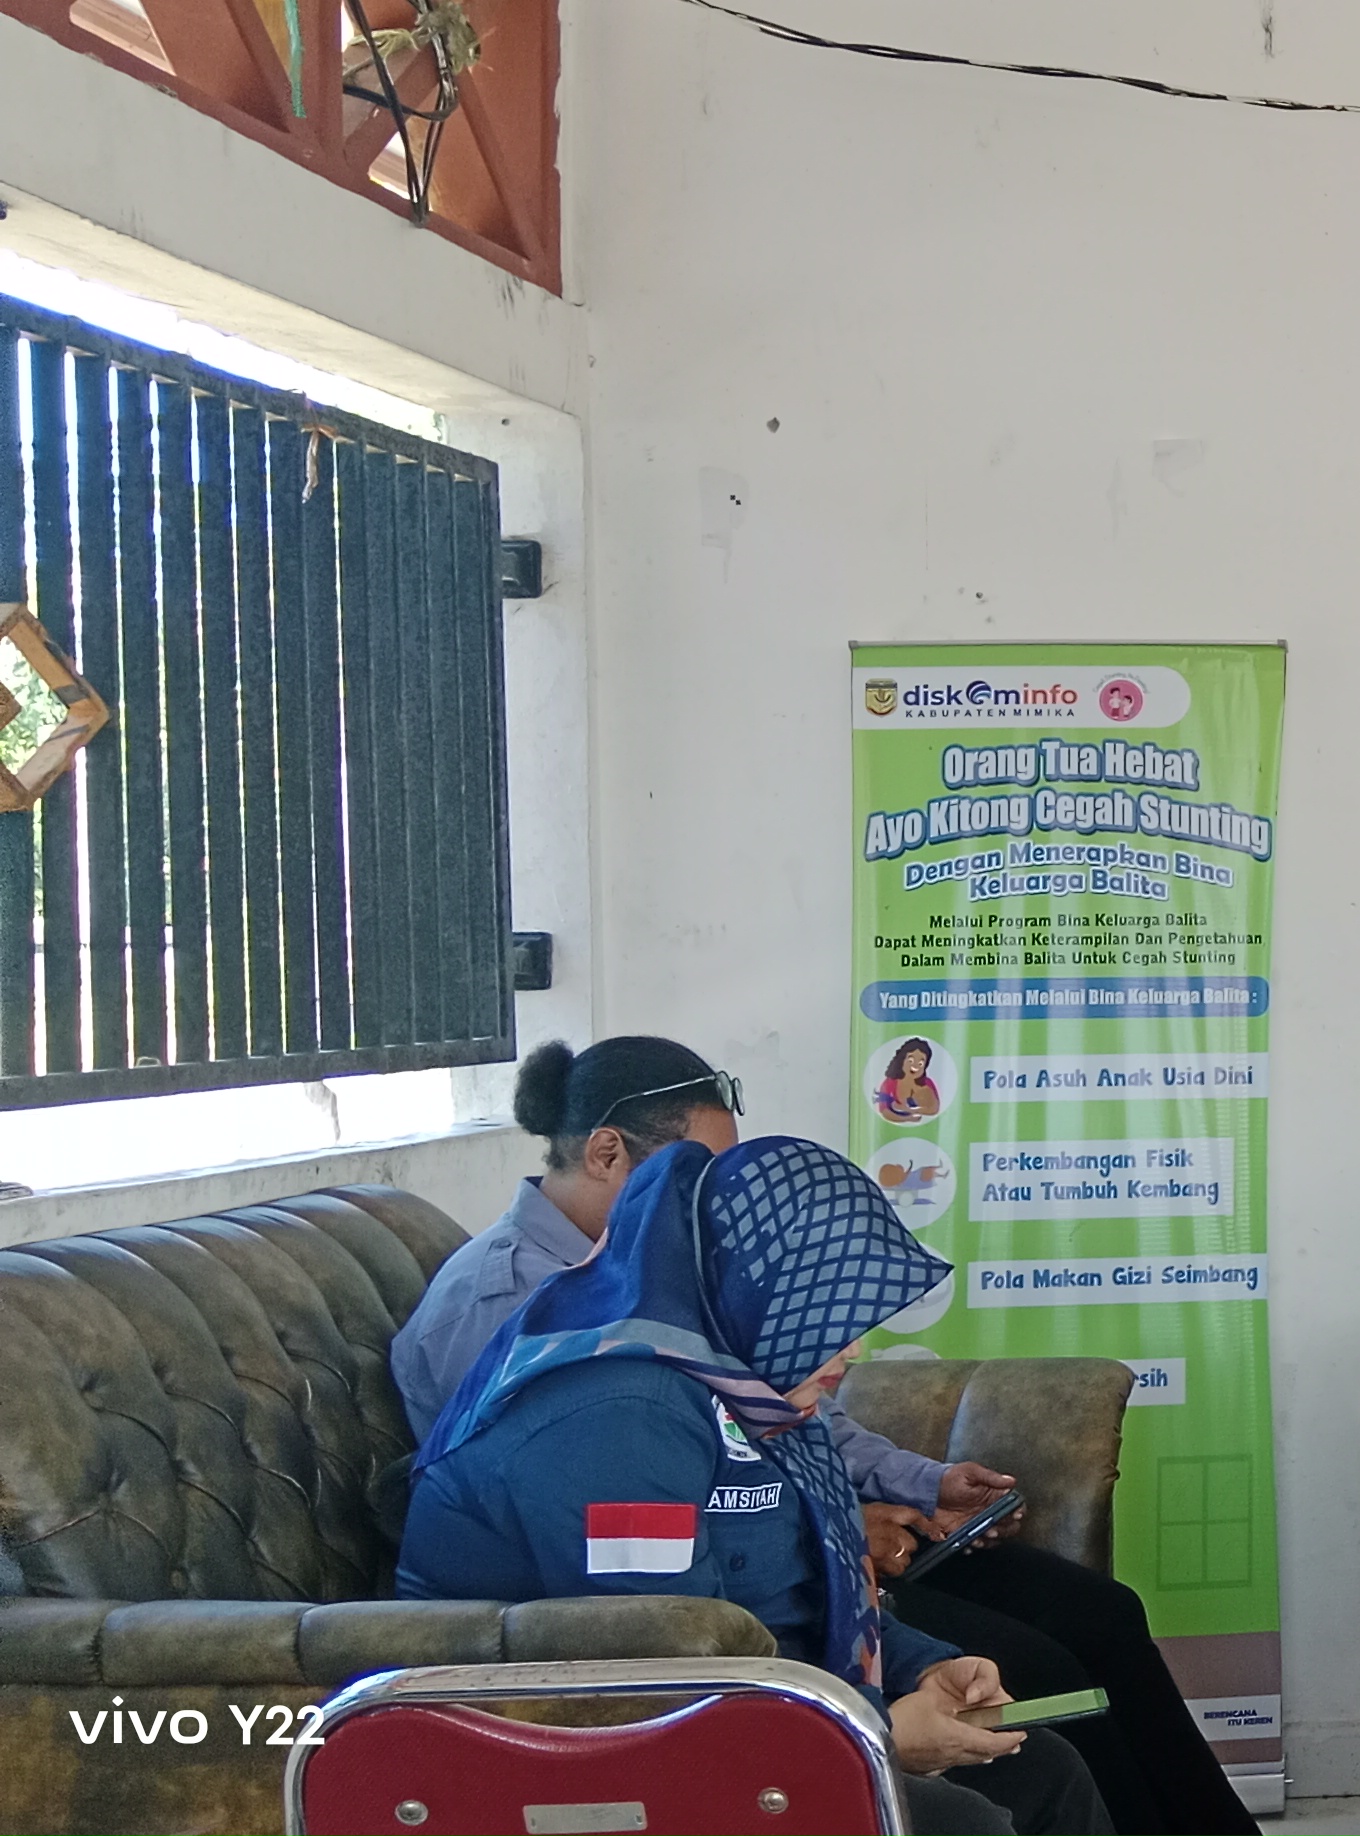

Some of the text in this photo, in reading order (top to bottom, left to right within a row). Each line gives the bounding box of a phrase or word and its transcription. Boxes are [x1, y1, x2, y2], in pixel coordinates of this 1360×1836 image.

[905, 708, 1075, 718] KABUPATEN MIMIKA
[944, 741, 1197, 785] Orang Tua Hebat
[867, 791, 1270, 856] Ayo Kitong Cegah Stunting
[907, 843, 1232, 887] Dengan Menerapkan Bina
[970, 871, 1168, 898] Keluarga Balita
[930, 913, 1207, 930] Melalui Program Bina Keluarga Balita
[874, 935, 917, 950] Dapat
[922, 933, 1027, 949] Meningkatkan
[1031, 932, 1130, 949] Keterampilan
[1134, 932, 1163, 945] Dan
[901, 950, 1236, 967] Dalam Membina Balita Untuk Cegah Stunting
[879, 991, 918, 1010] Yang
[921, 990, 1023, 1008] Ditingkatkan
[1026, 989, 1086, 1006] Melalui
[1089, 989, 1124, 1005] Bina
[1128, 988, 1200, 1007] Keluarga
[983, 1066, 1253, 1089] Pola Asuh Anak Usia Dini
[982, 1148, 1194, 1178] Perkembangan Fisik
[982, 1179, 1219, 1205] Atau Tumbuh Kembang
[981, 1264, 1258, 1290] Pola Makan Gizi Seimbang
